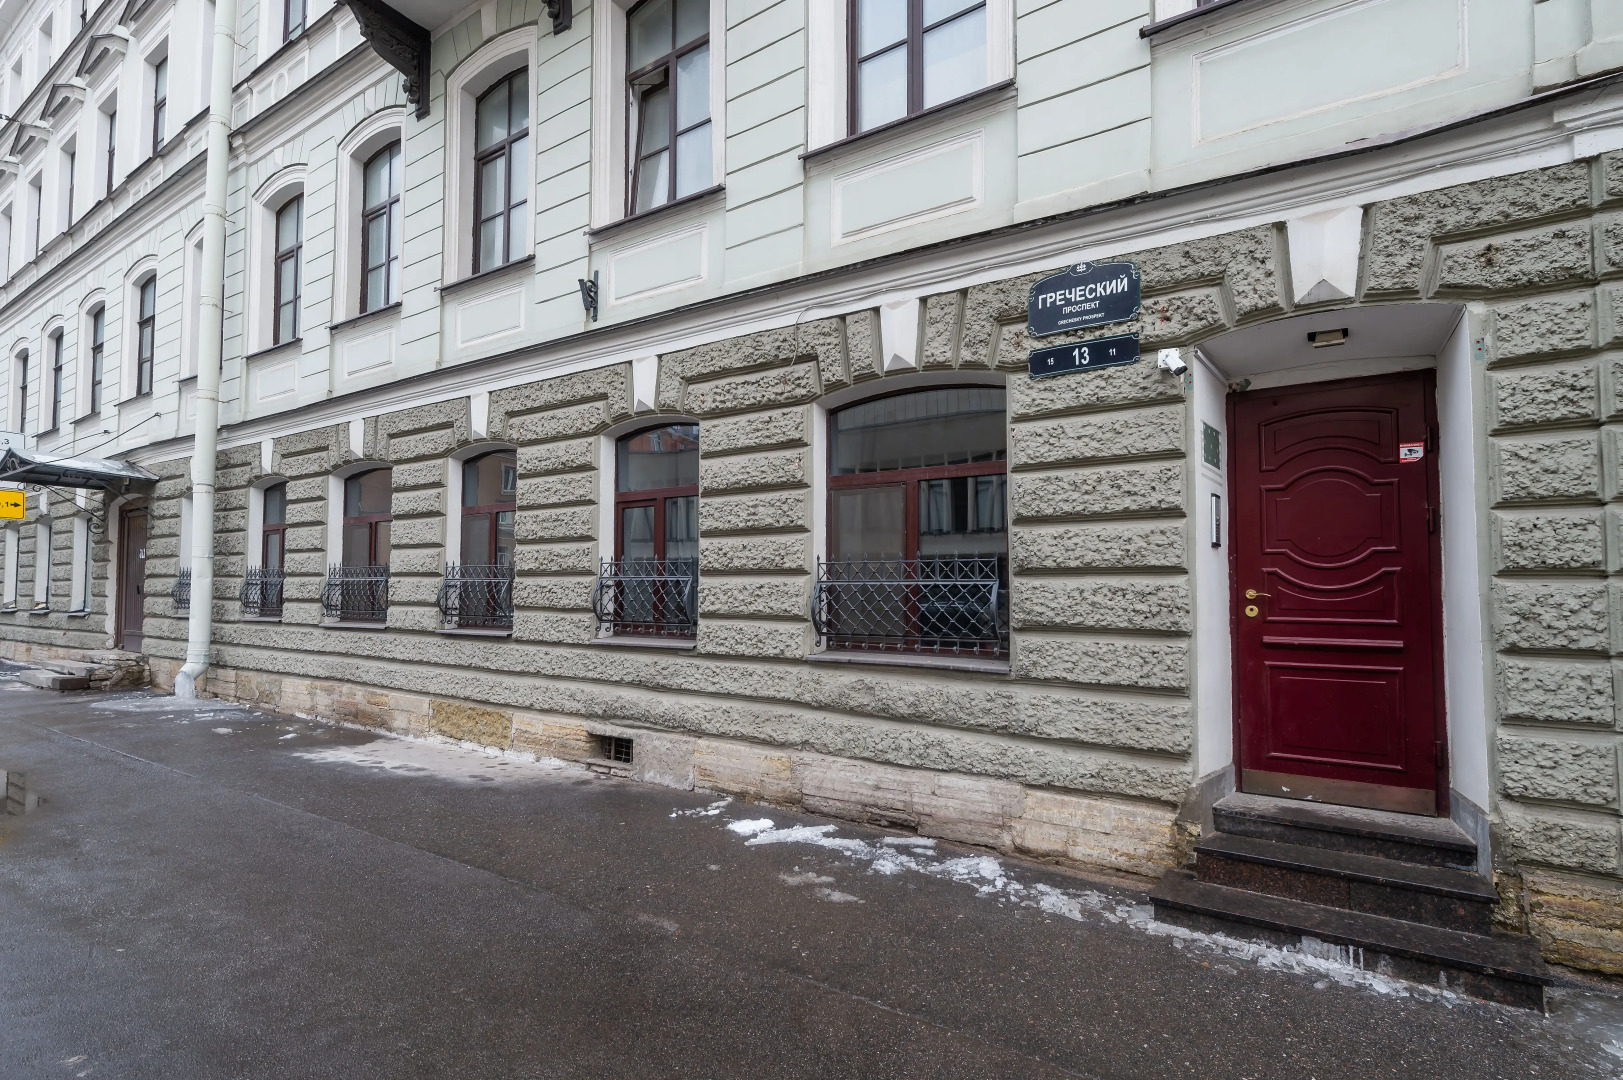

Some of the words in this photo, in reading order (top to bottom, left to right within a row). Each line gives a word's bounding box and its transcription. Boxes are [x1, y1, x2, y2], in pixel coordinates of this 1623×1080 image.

[1038, 274, 1128, 309] ГРЕЧЕСКИЙ
[1062, 300, 1100, 315] ПРОСПЕКТ
[1047, 357, 1054, 366] 15
[1072, 346, 1090, 366] 13
[1109, 348, 1116, 356] 11
